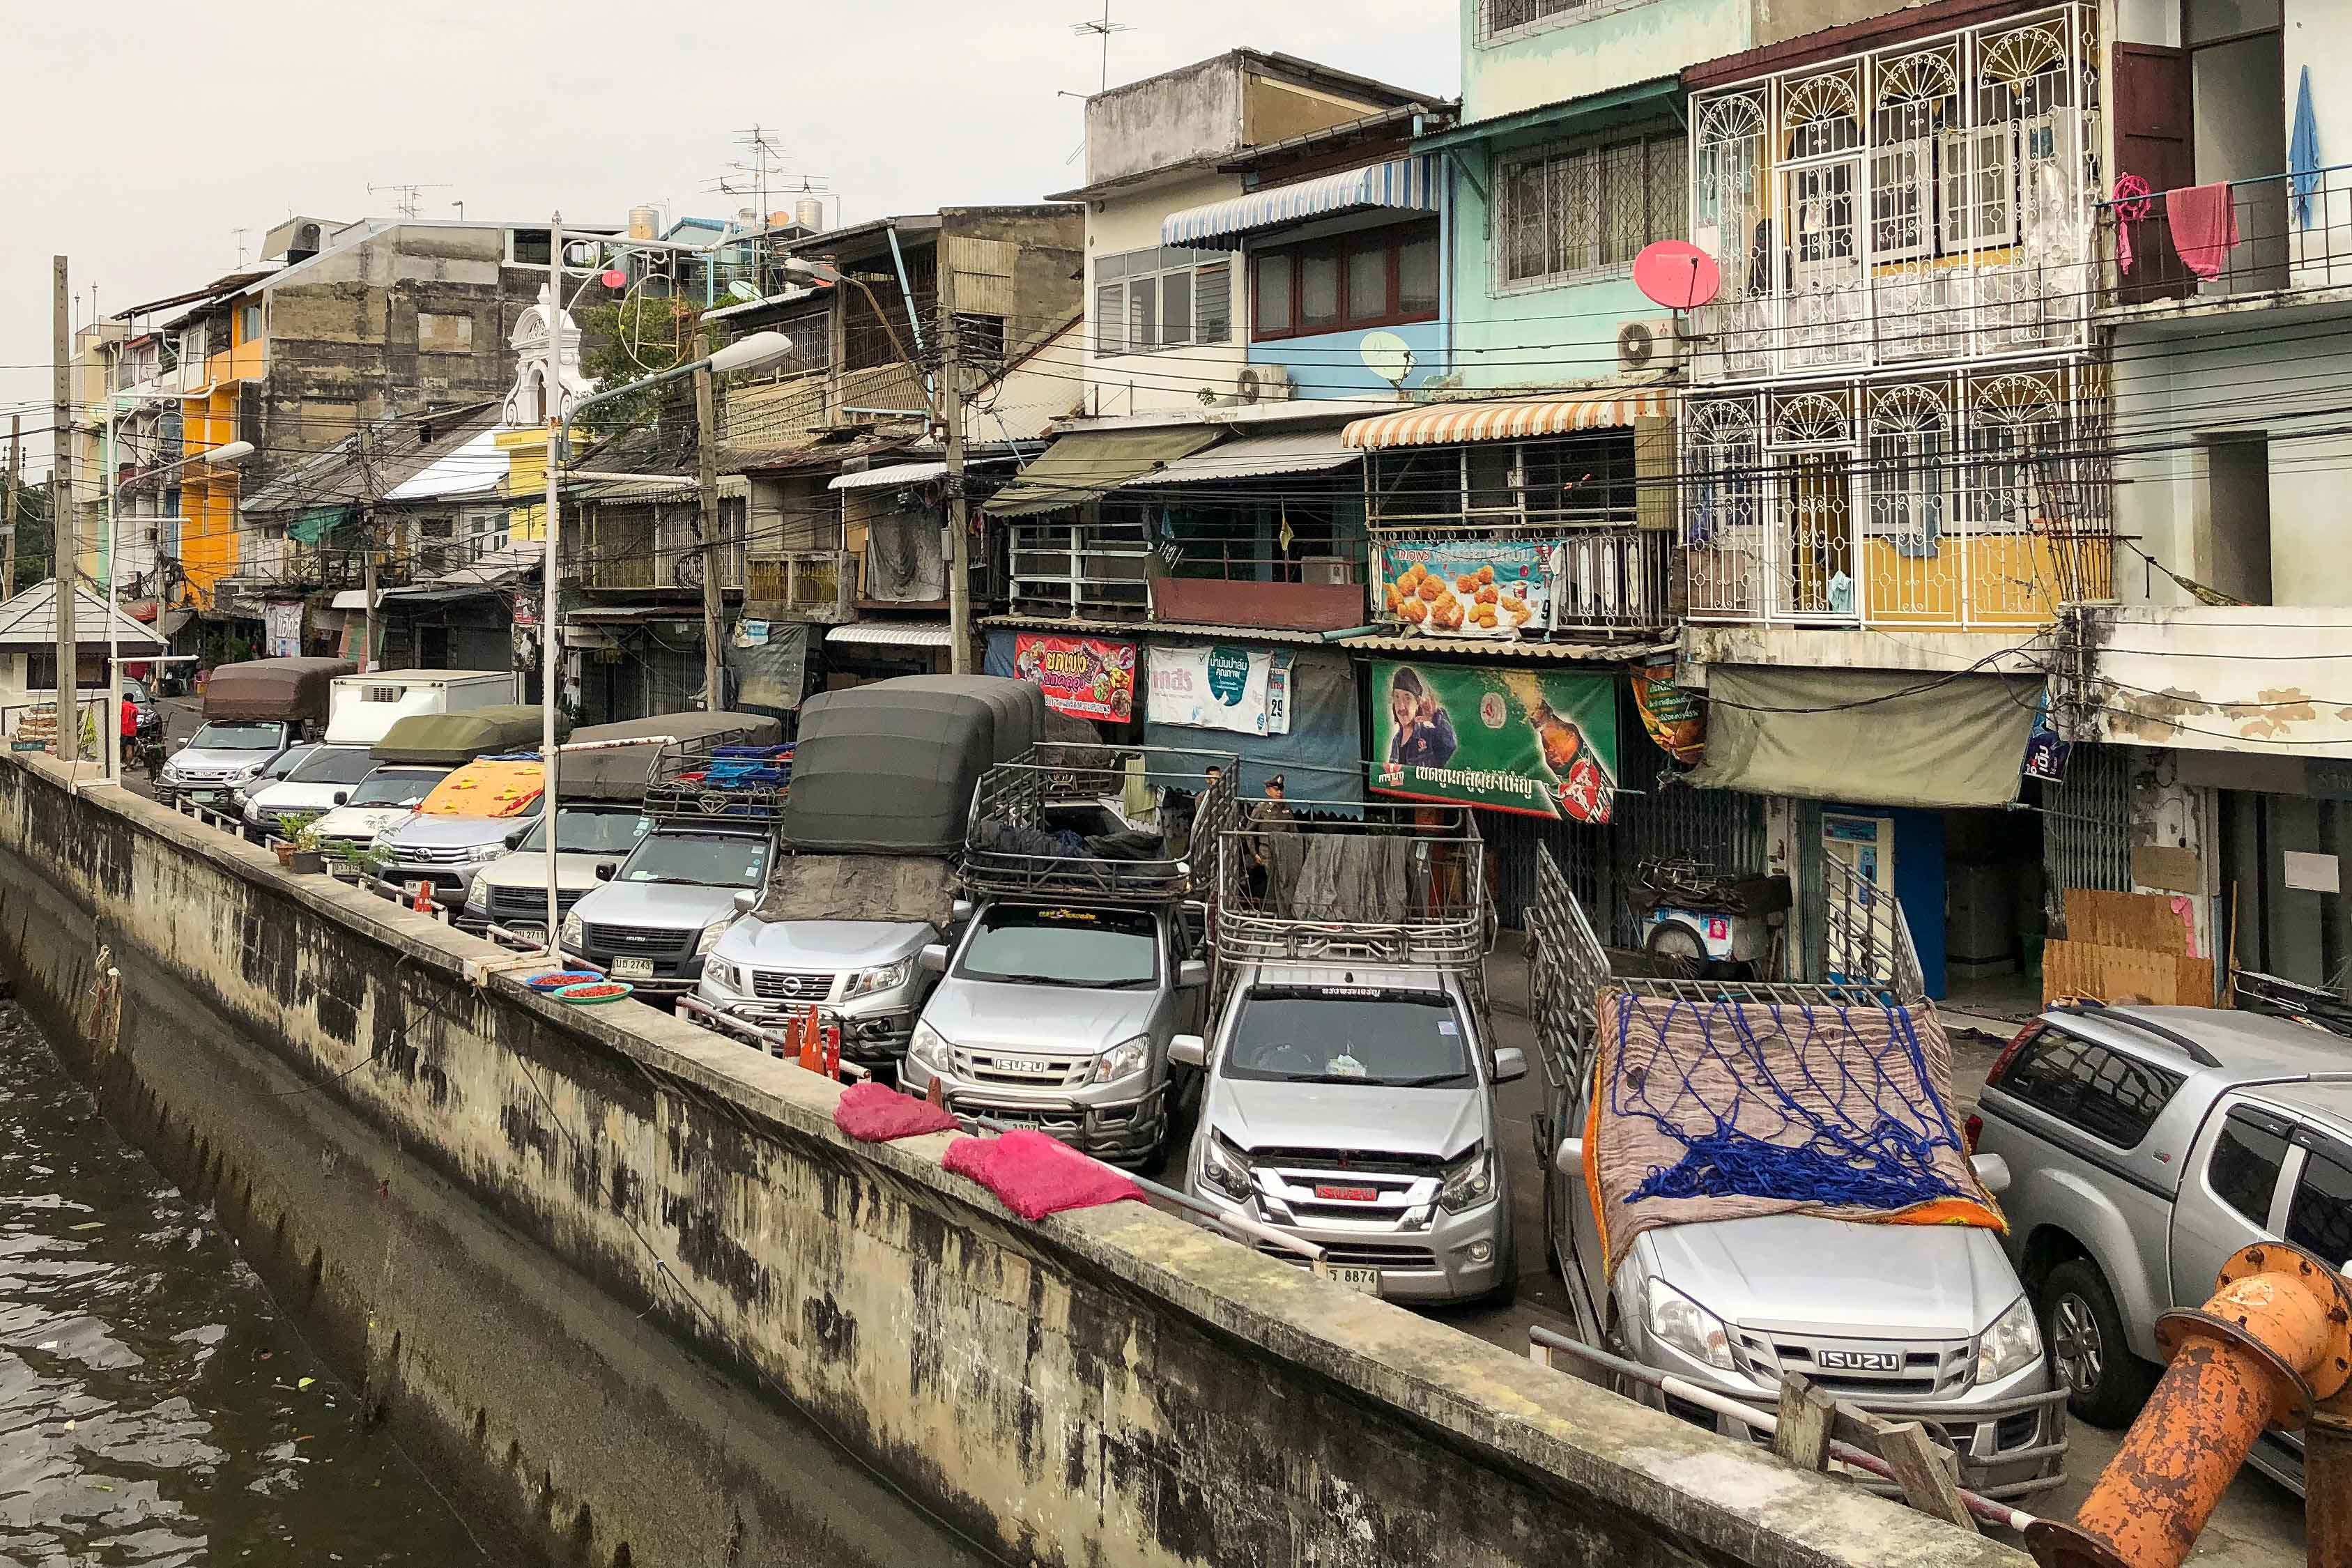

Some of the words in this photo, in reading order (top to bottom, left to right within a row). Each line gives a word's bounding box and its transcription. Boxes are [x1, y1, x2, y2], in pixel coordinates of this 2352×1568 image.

[1210, 652, 1247, 670] น้ำมันปาล์ม
[1271, 699, 1283, 717] 29
[630, 960, 650, 970] 2743
[997, 1060, 1043, 1072] ISUZU
[1316, 1186, 1376, 1201] ISUZU
[1344, 1270, 1375, 1283] 8874
[1821, 1351, 1897, 1369] ISUZU
